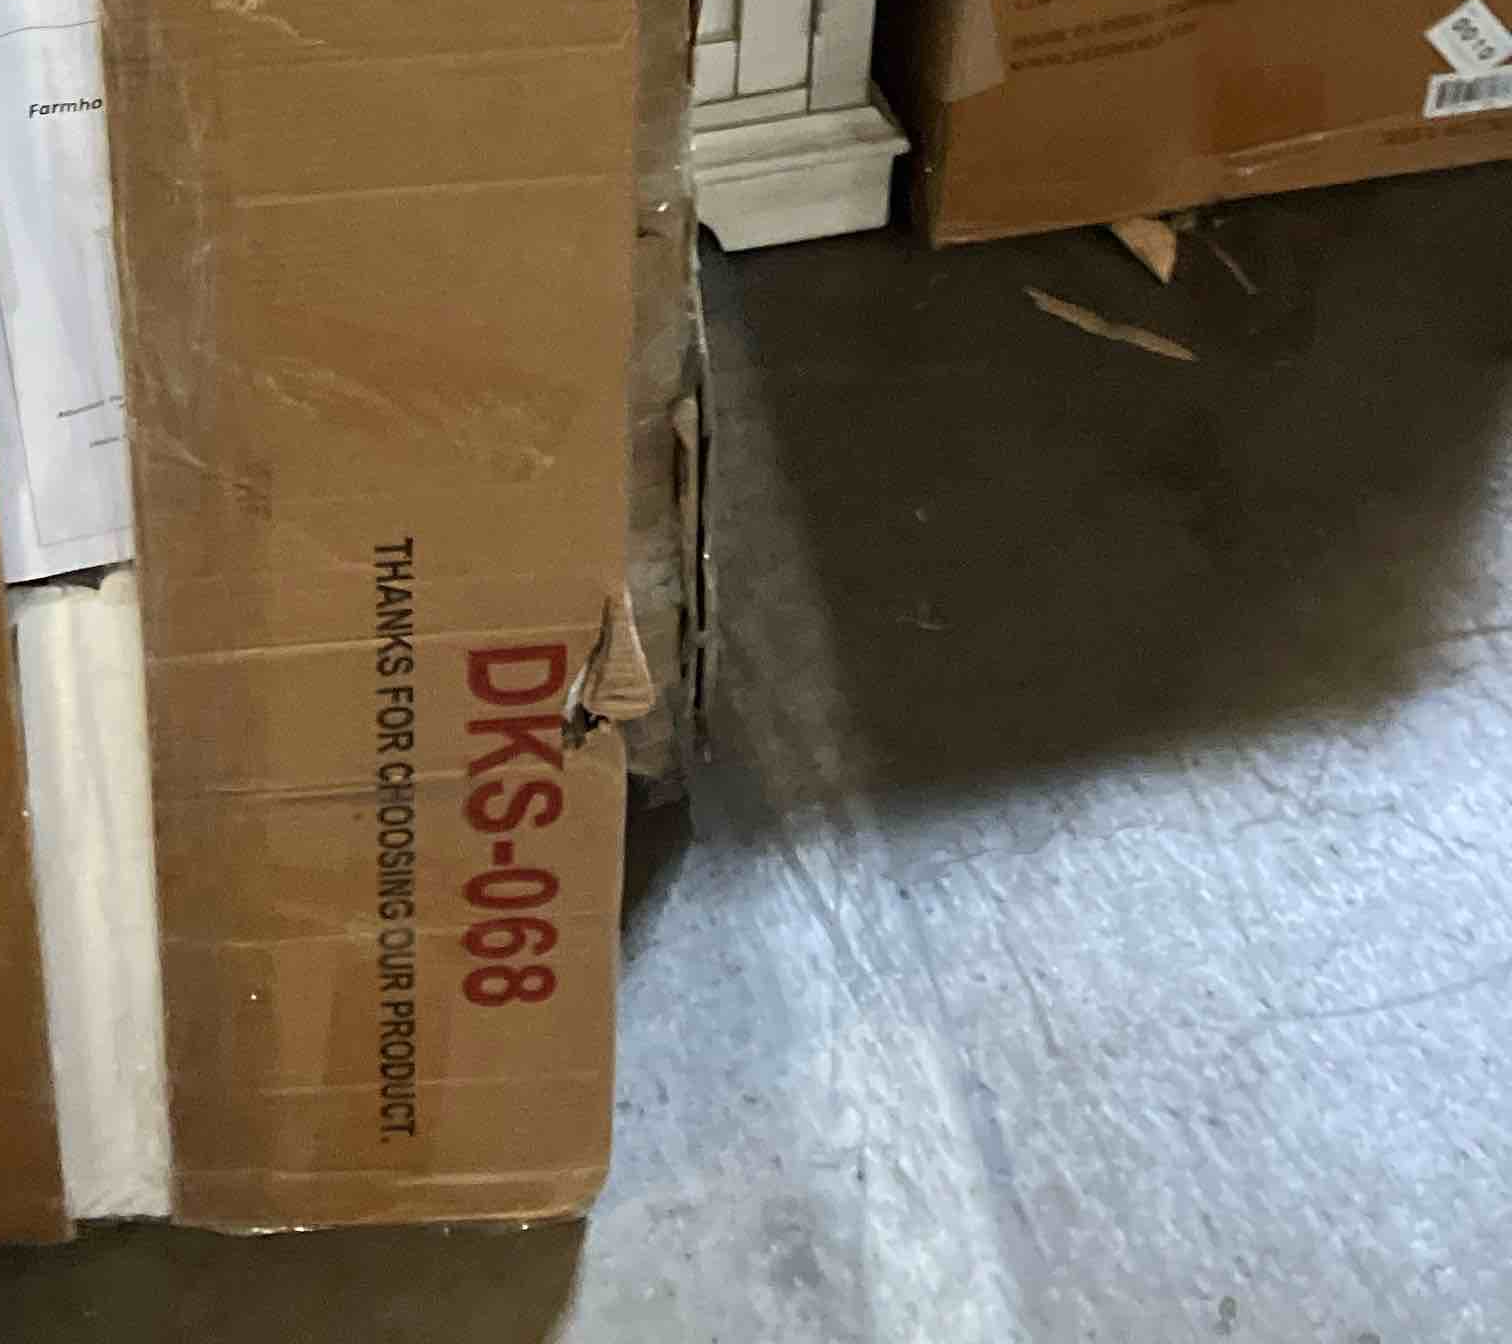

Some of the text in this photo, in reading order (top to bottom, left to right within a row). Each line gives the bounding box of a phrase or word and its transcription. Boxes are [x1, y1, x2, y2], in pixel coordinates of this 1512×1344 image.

[28, 97, 103, 119] Farmho
[374, 536, 417, 1145] THANKS FOR CHOOSING OUR PRODUCT.
[461, 643, 568, 1008] DKS-068
